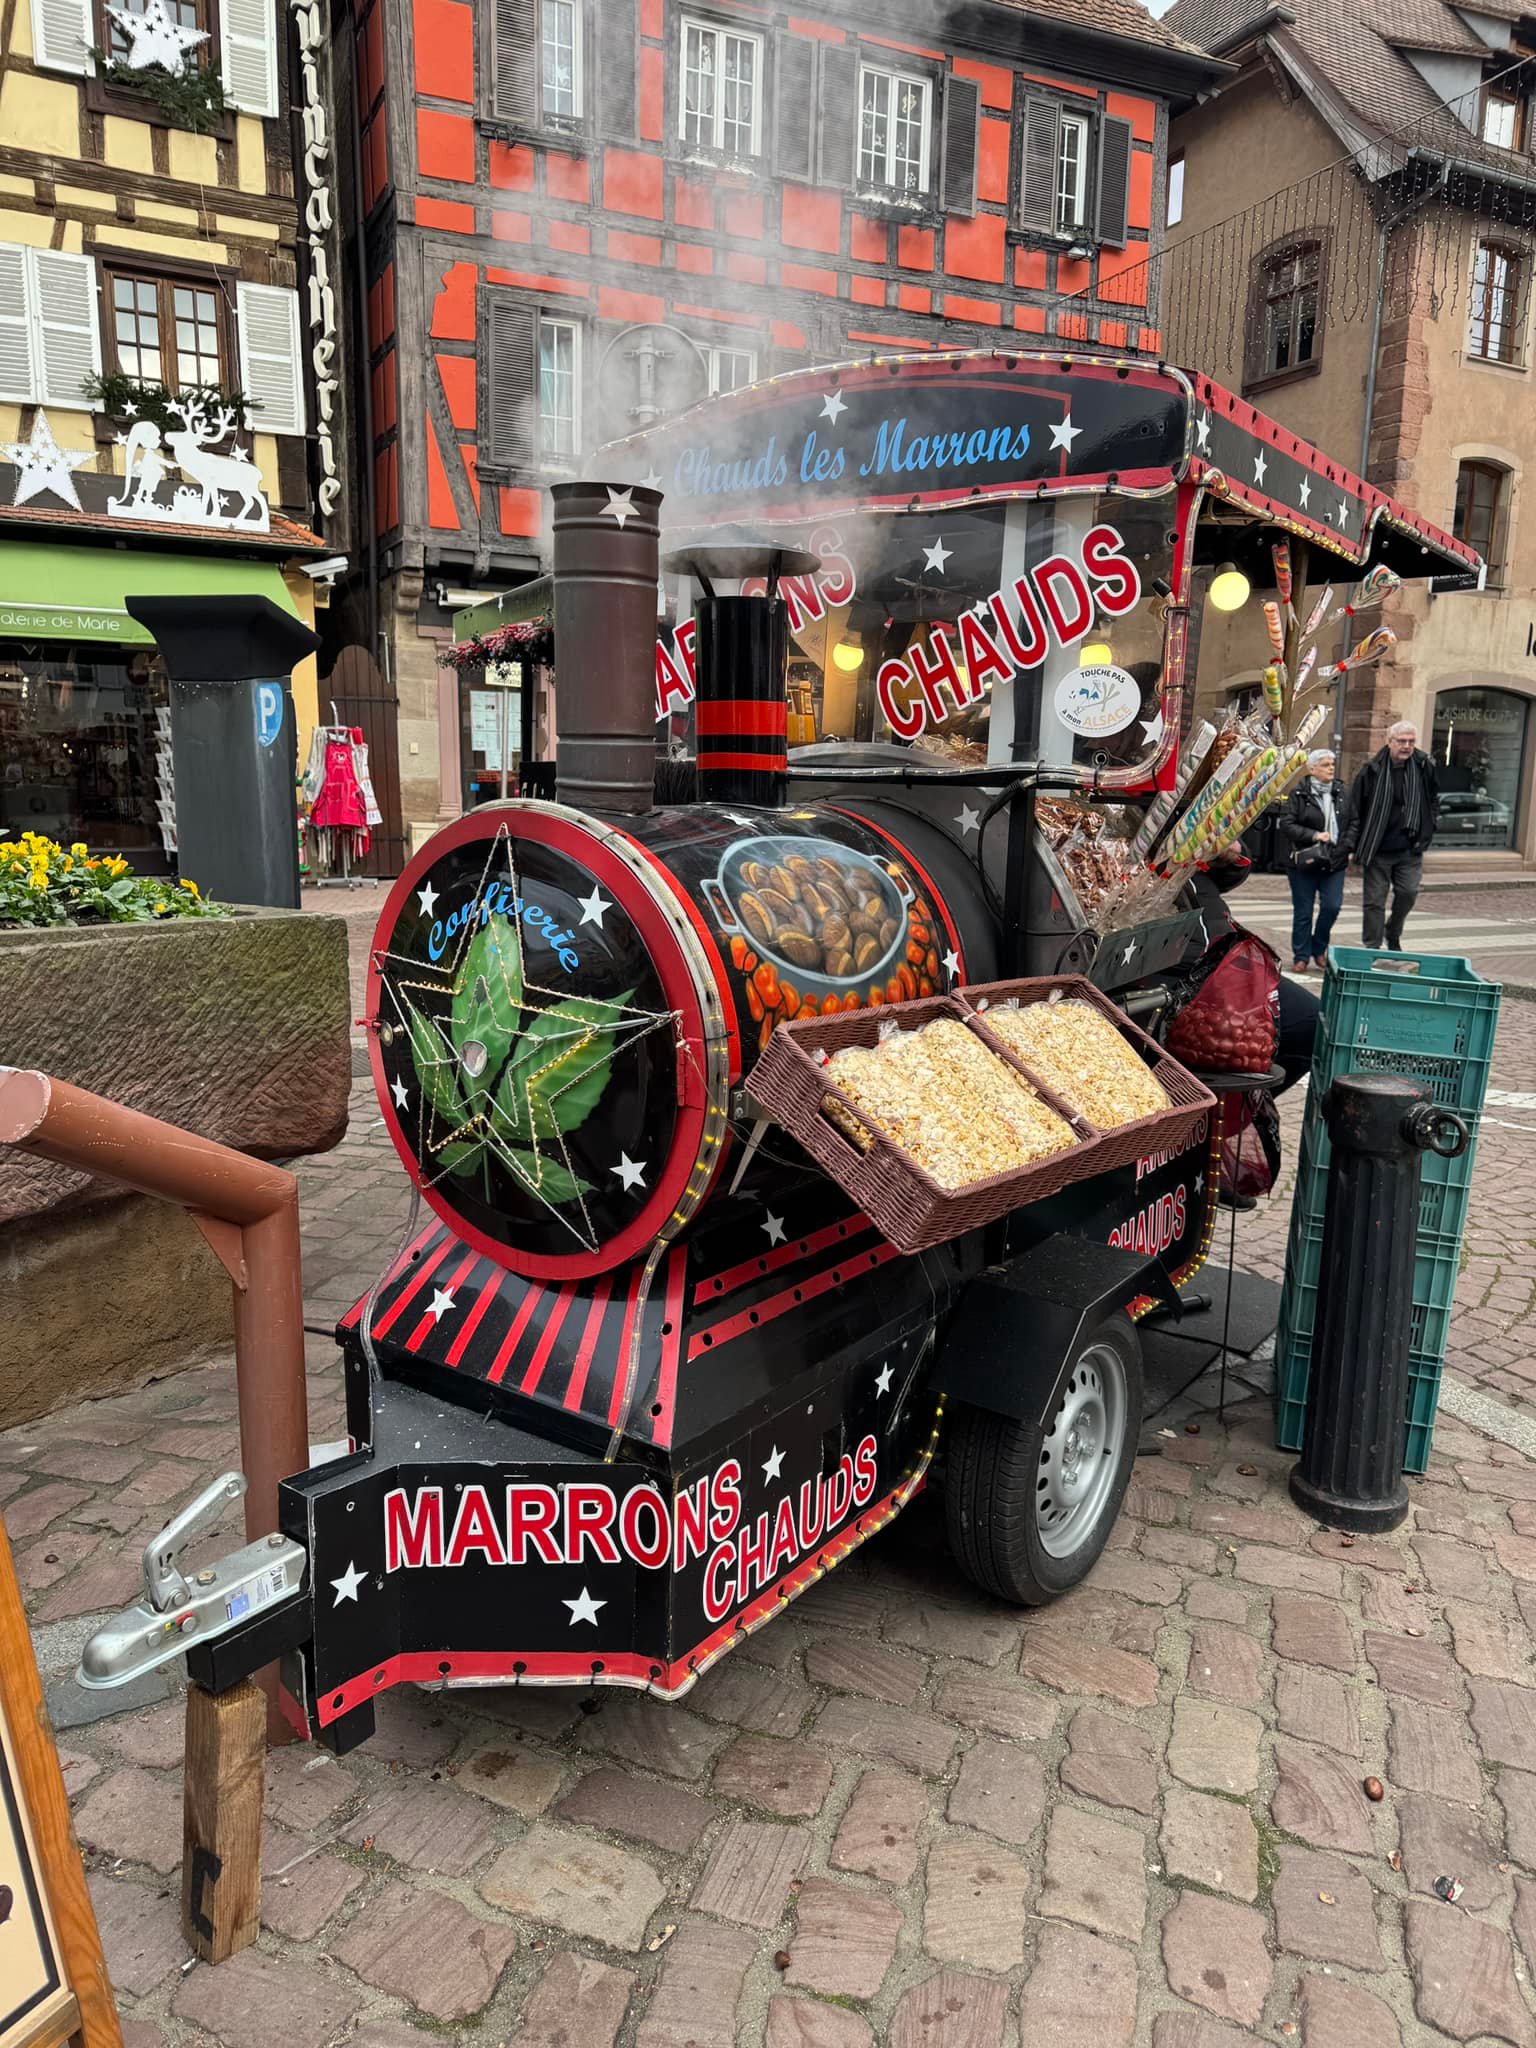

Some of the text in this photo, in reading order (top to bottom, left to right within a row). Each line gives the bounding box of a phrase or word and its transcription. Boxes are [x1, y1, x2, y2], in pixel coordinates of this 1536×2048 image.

[289, 0, 341, 517] uincaillerie
[673, 417, 1032, 499] Chauds les Marrons
[0, 612, 121, 632] alerie de Marie
[876, 523, 1142, 741] CHAUDS
[259, 687, 276, 734] P
[1066, 714, 1082, 726] mon
[1083, 703, 1133, 728] ALSACE
[1080, 668, 1126, 684] TOUCHE PAS
[428, 881, 581, 975] Confiserie
[384, 1458, 742, 1574] MARRONS
[702, 1434, 878, 1625] CHAUDS
